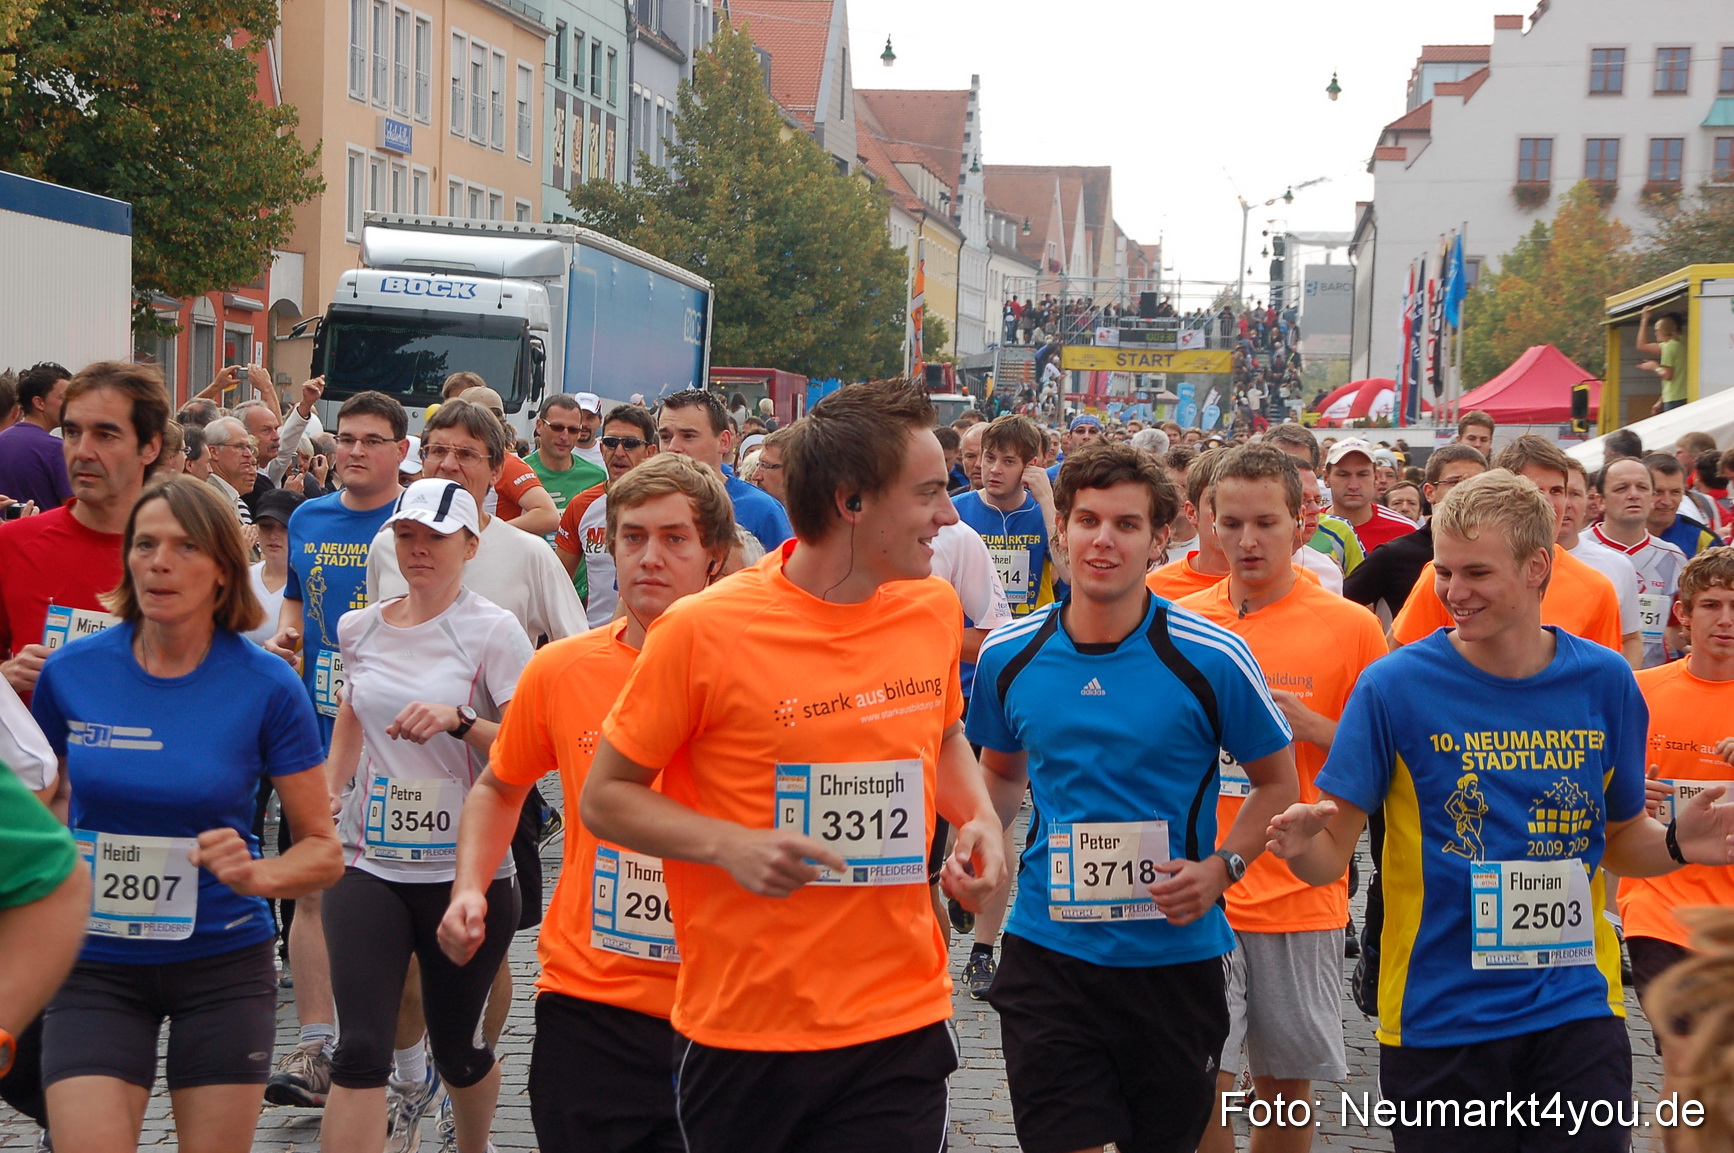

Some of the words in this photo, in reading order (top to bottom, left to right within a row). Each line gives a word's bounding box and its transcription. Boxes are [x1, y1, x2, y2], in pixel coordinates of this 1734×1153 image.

[380, 277, 477, 299] BOCK
[1116, 352, 1175, 367] START
[514, 472, 536, 485] MERZ
[981, 534, 1041, 545] EUMRKTER
[303, 543, 317, 554] 10.
[803, 693, 852, 718] stark
[855, 677, 942, 708] ausbildung
[1080, 688, 1106, 696] adidas
[860, 700, 942, 723] www.starkausbildung.de
[1430, 733, 1460, 752] 10.
[1464, 730, 1605, 751] NEUMARKTER
[1665, 740, 1698, 752] stark
[1462, 750, 1586, 771] STADTLAUF
[820, 771, 904, 798] Christoph
[391, 785, 422, 801] Petra
[372, 806, 378, 817] D
[786, 808, 794, 823] C
[1660, 806, 1665, 815] C
[391, 810, 451, 832] 3540
[822, 808, 909, 841] 3312
[1080, 833, 1120, 850] Peter
[1527, 837, 1590, 858] 20.09.209
[103, 842, 140, 862] Heidi
[870, 864, 923, 876] PFLEIDERER
[1056, 861, 1062, 873] C
[1083, 859, 1156, 886] 3718
[103, 873, 181, 901] 2807
[1510, 872, 1561, 890] Florian
[599, 884, 606, 898] C
[1481, 902, 1489, 915] C
[1512, 900, 1582, 930] 2503
[144, 924, 192, 932] PFLEIDERER
[1551, 947, 1593, 959] PFLEIDERER
